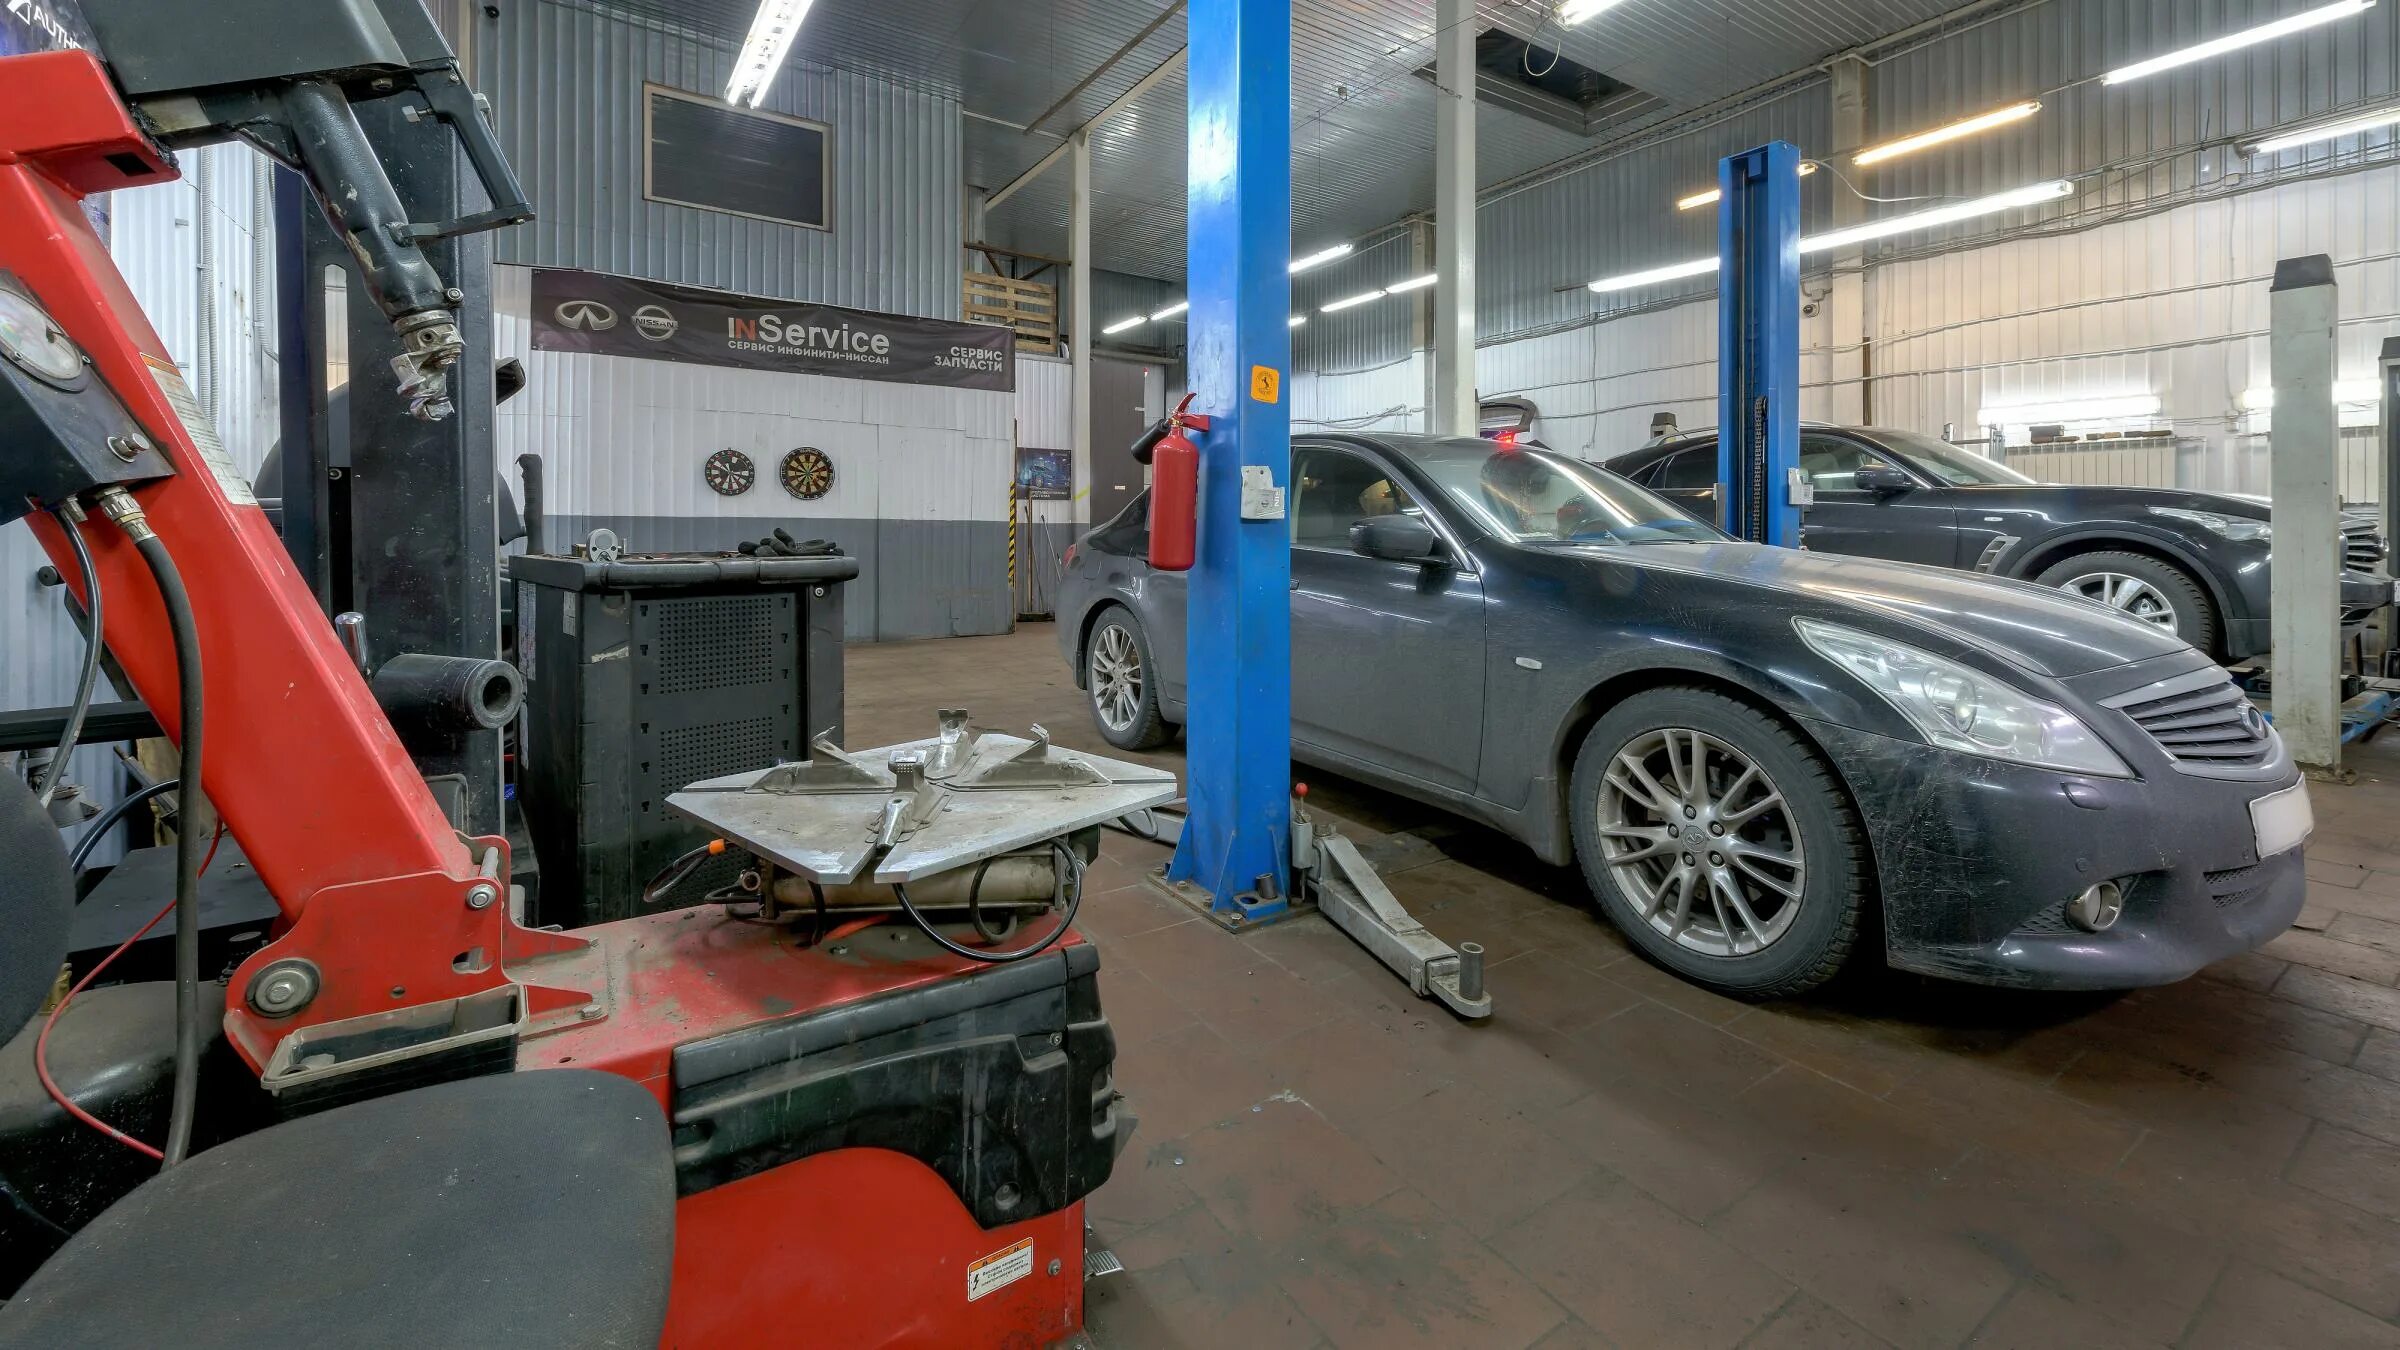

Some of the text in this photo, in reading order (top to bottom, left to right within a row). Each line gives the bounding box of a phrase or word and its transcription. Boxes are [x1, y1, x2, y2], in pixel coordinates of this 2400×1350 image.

[635, 318, 675, 328] NISSAN
[728, 314, 890, 355] INService
[728, 340, 889, 365] СЕРВИС ИНФИНИТИ-НИССАН
[950, 346, 1003, 361] СЕРВИС
[934, 355, 1003, 372] ЗАПЧАСТИ
